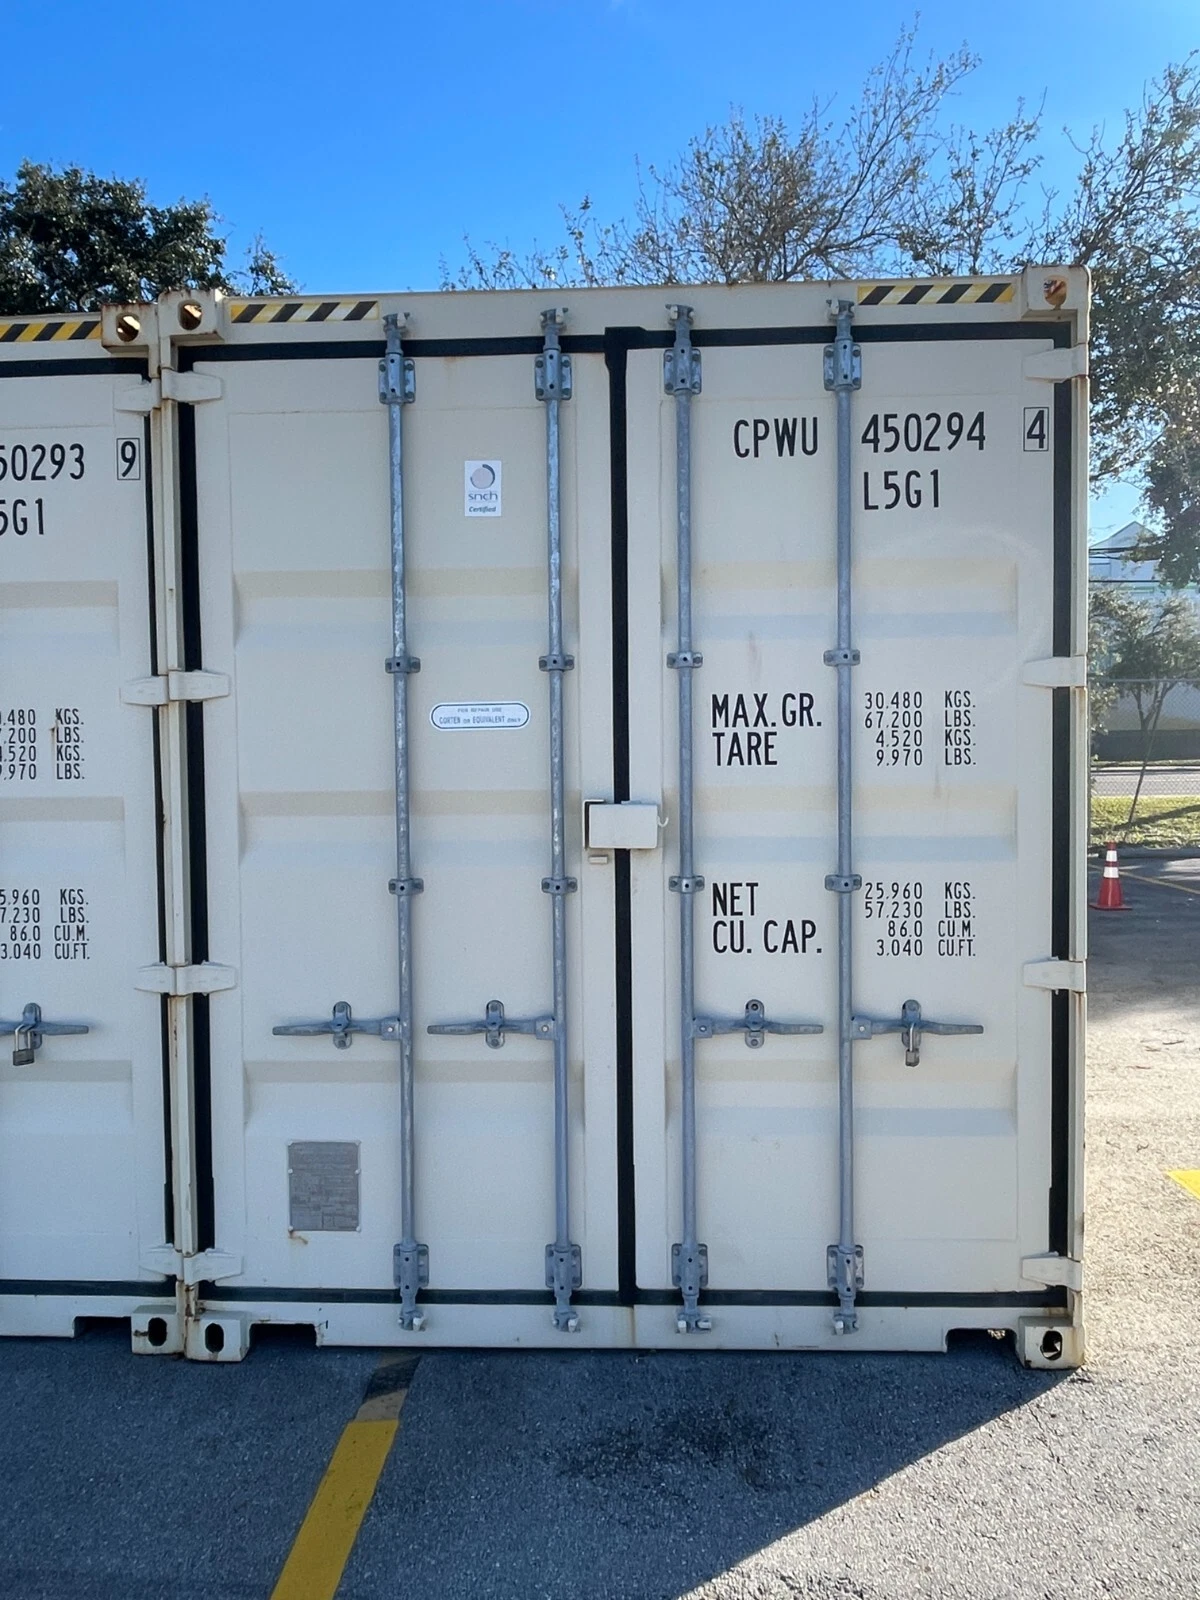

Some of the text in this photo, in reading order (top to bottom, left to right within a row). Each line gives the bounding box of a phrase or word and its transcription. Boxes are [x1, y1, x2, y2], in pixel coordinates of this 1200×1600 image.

[734, 410, 1046, 458] CPWU 450294 4
[120, 440, 137, 477] 9
[468, 491, 498, 501] snch
[864, 469, 939, 510] L5G1
[945, 690, 976, 708] KGS.
[55, 708, 84, 726] KGS.
[945, 709, 976, 728] LBS.
[56, 726, 84, 744] LBS.
[945, 728, 976, 747] KGS.
[56, 744, 85, 762] KGS.
[712, 731, 778, 767] TARE
[945, 747, 977, 766] LBS.
[56, 763, 85, 780] LBS.
[60, 888, 89, 905] KGS.
[712, 882, 759, 917] NET
[945, 881, 976, 900] KGS.
[60, 906, 90, 924] LBS.
[945, 900, 976, 919] LBS.
[10, 924, 41, 942] 86.0
[712, 919, 823, 954] CU. CAP.
[887, 919, 976, 938] 86.0 CU.M.
[938, 938, 976, 957] CU.FT.
